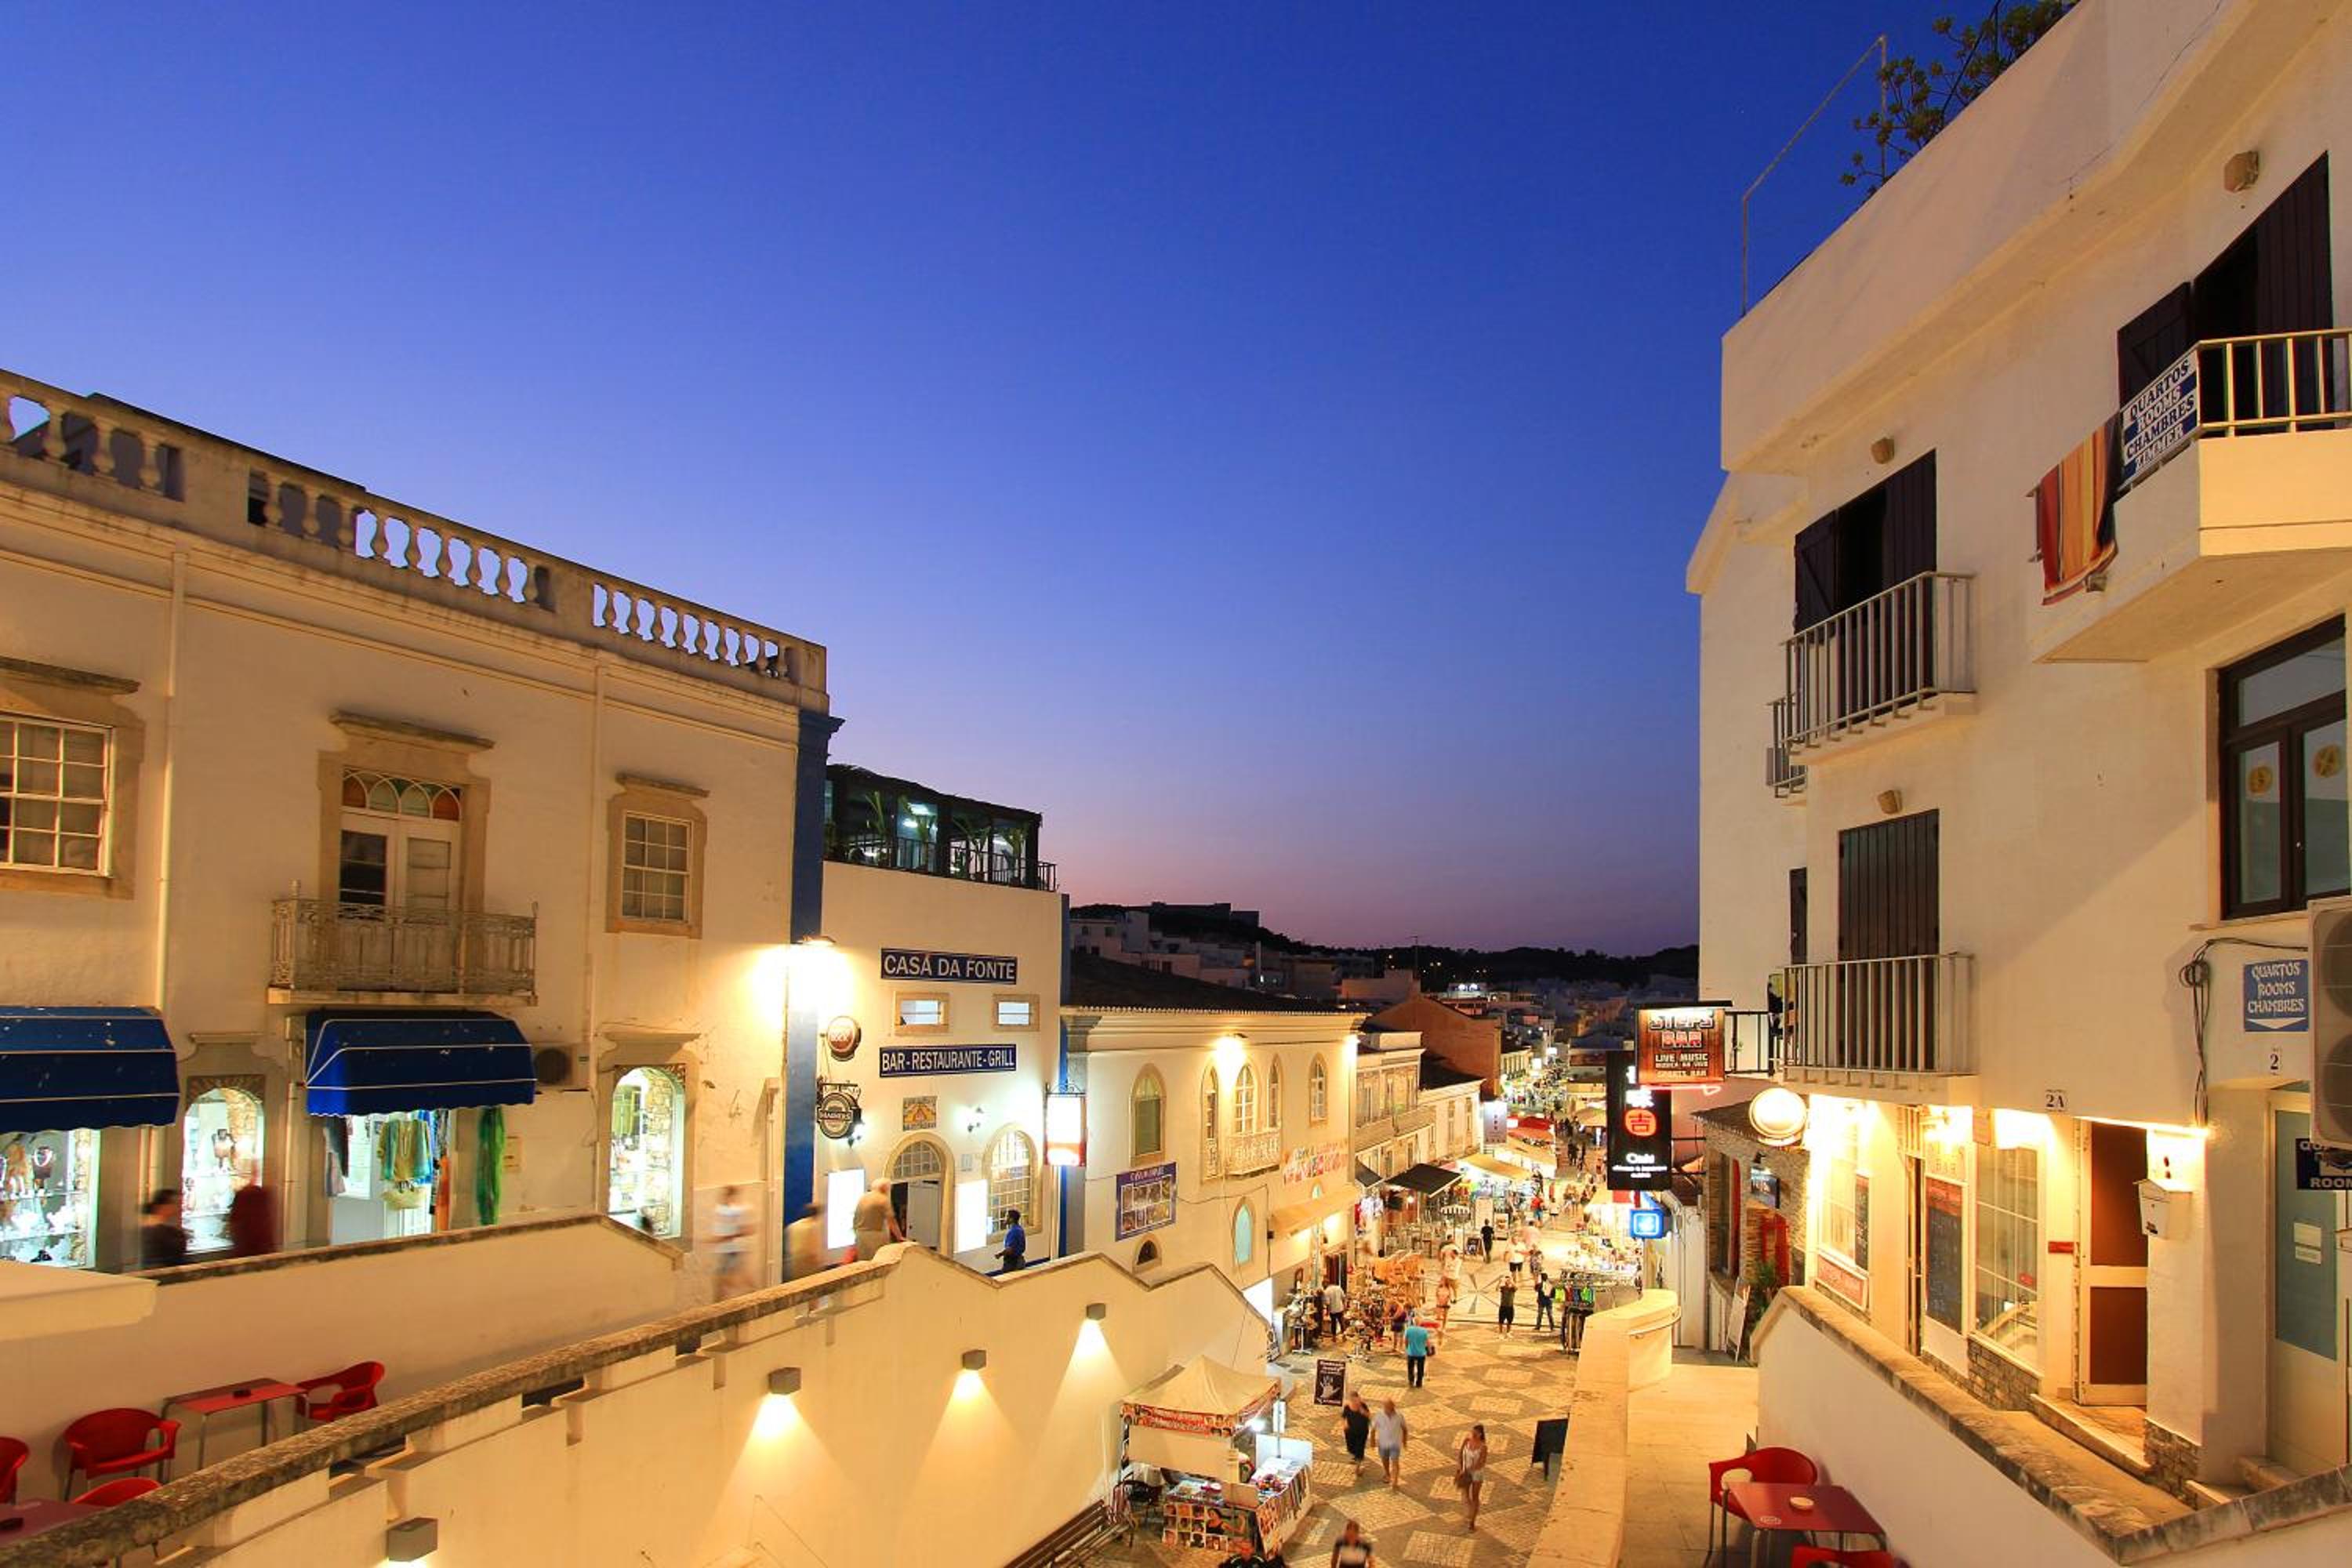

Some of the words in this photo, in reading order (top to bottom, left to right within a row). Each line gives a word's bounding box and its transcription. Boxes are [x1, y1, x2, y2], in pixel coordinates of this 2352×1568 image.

[2129, 359, 2190, 422] QUARTOS
[2137, 384, 2182, 433] ROOMS
[2126, 394, 2194, 459] CHAMBRES
[884, 954, 932, 976] CASA
[938, 958, 960, 977] DA
[966, 960, 1014, 980] FONTE
[2251, 961, 2301, 981] QUARTOS
[2257, 980, 2296, 999] ROOMS
[2248, 997, 2305, 1014] CHAMBRES
[1655, 1053, 1675, 1062] LIVE
[1680, 1053, 1708, 1062] MUSIC
[2269, 1053, 2279, 1070] 2
